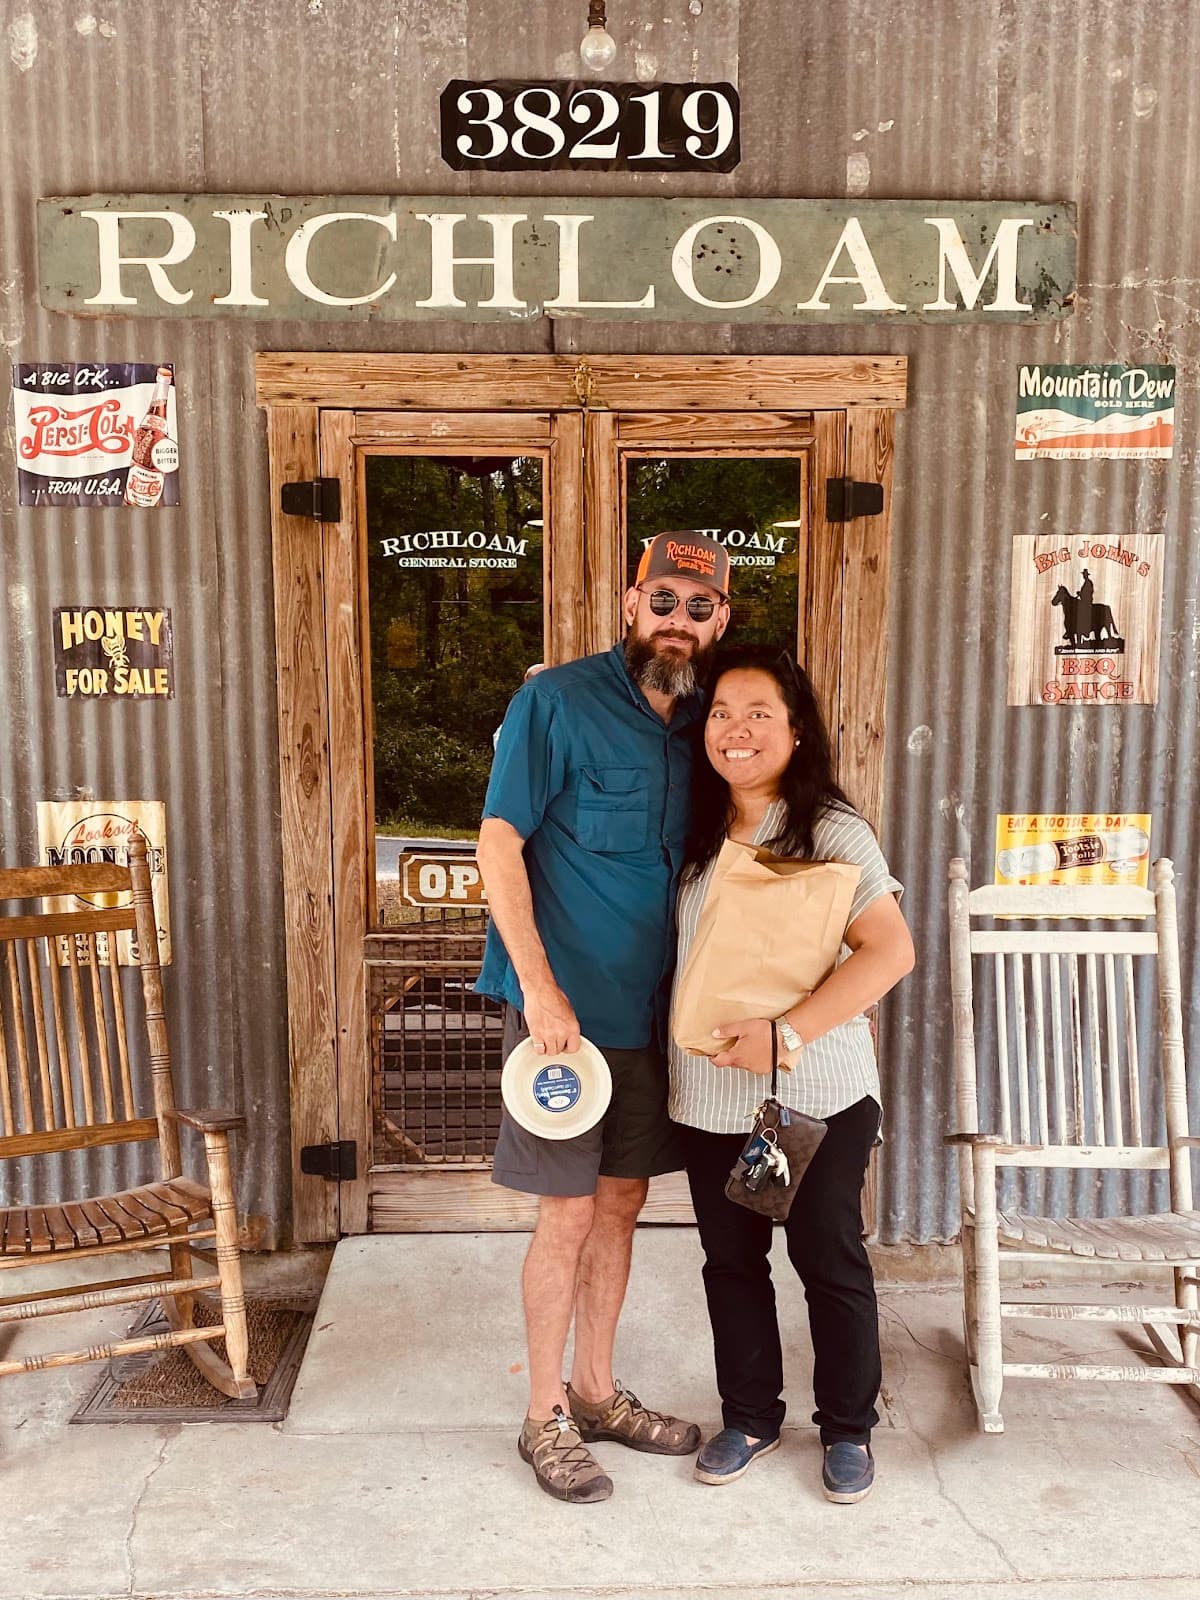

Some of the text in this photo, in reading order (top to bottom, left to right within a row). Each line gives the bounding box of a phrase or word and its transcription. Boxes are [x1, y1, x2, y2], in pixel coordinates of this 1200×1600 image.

[456, 89, 735, 161] 38219
[80, 212, 1034, 312] RICHLOAM
[23, 374, 37, 386] A
[41, 372, 71, 386] BIG
[1019, 366, 1174, 399] Mountain Dew
[1094, 400, 1155, 409] SOLD HERE
[84, 478, 122, 496] U.S.A.
[379, 530, 529, 557] RICHLOAM
[666, 541, 716, 563] RICHLOAM
[399, 557, 517, 568] GENERAL STORE
[1033, 540, 1150, 577] BIG JOHN'S
[60, 610, 164, 650] HONEY
[1062, 657, 1121, 680] BBQ
[66, 667, 168, 694] FOR SALE
[1042, 680, 1134, 704] SAUCE
[71, 819, 139, 845] Lookout
[1008, 816, 1128, 828] EAT A TOOTSIE A DAY
[1060, 842, 1100, 857] Tootsie
[1072, 852, 1096, 861] Rolls
